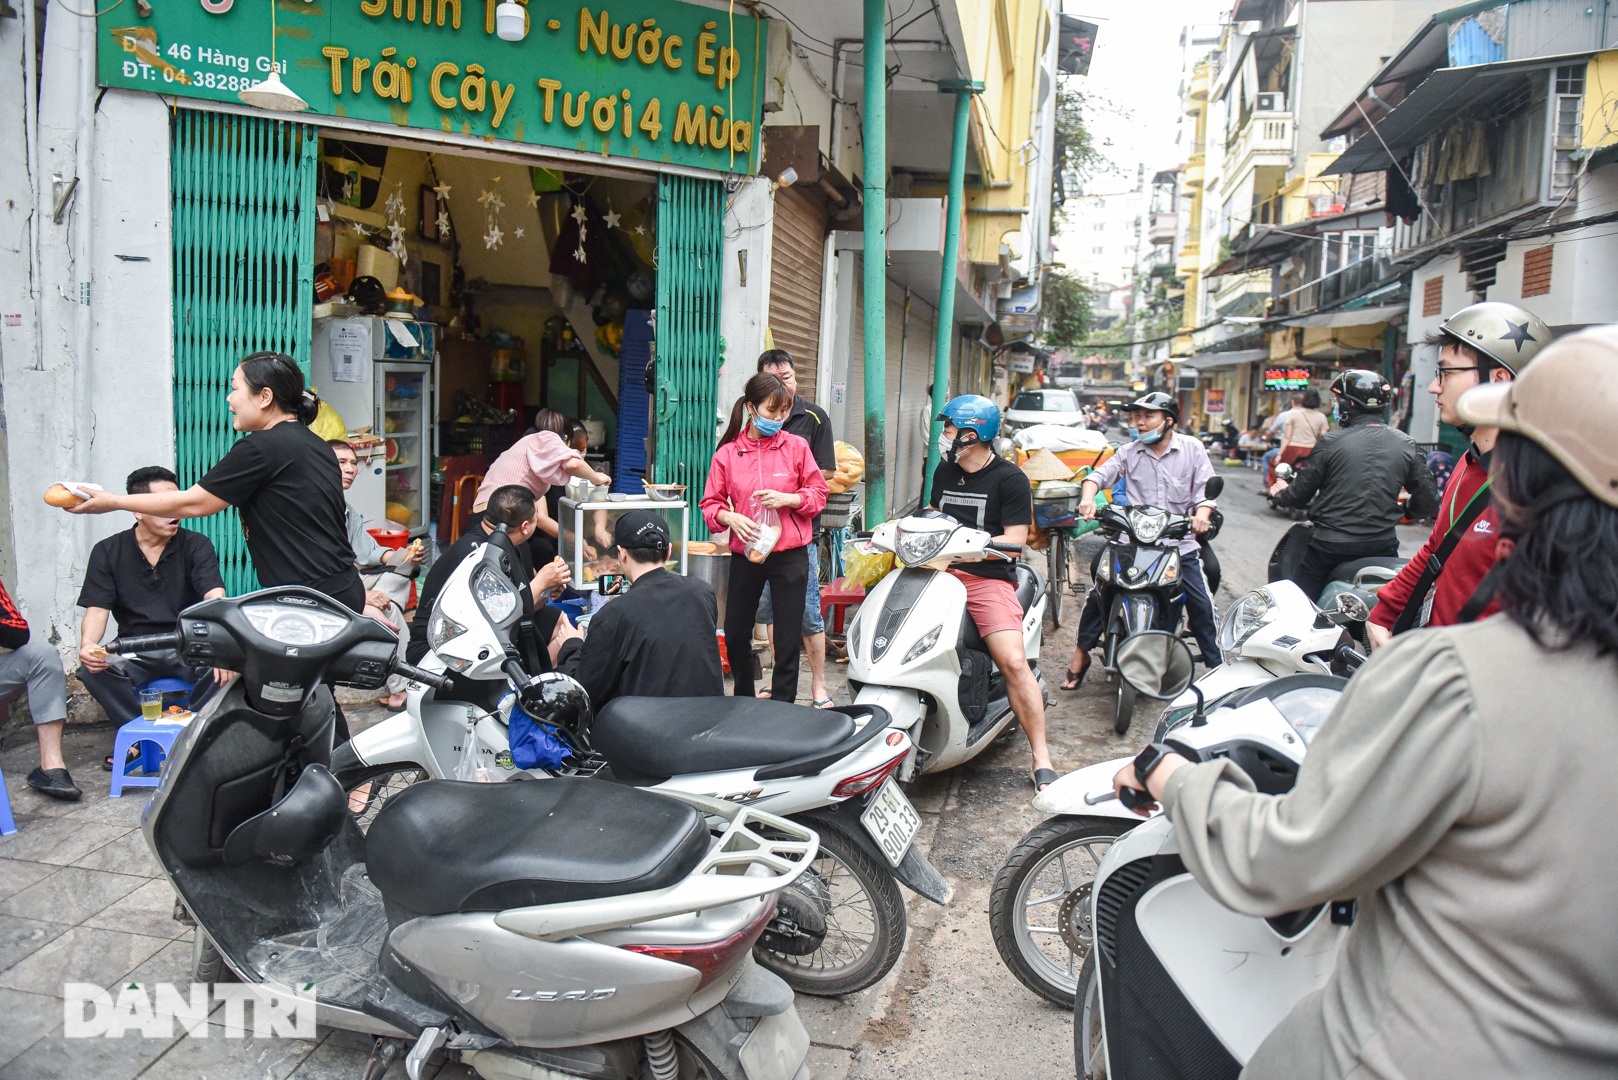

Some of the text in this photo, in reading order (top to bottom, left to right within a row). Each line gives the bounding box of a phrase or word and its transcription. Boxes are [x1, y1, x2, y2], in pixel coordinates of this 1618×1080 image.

[167, 43, 191, 60] 46
[198, 46, 249, 73] Hàng
[579, 7, 683, 69] Nước
[697, 21, 741, 90] Ép
[122, 61, 156, 80] ĐT:
[322, 46, 751, 153] Trái Cây Tươi 4 Mùa
[883, 805, 918, 860] 900.33
[505, 987, 617, 1002] LEAD
